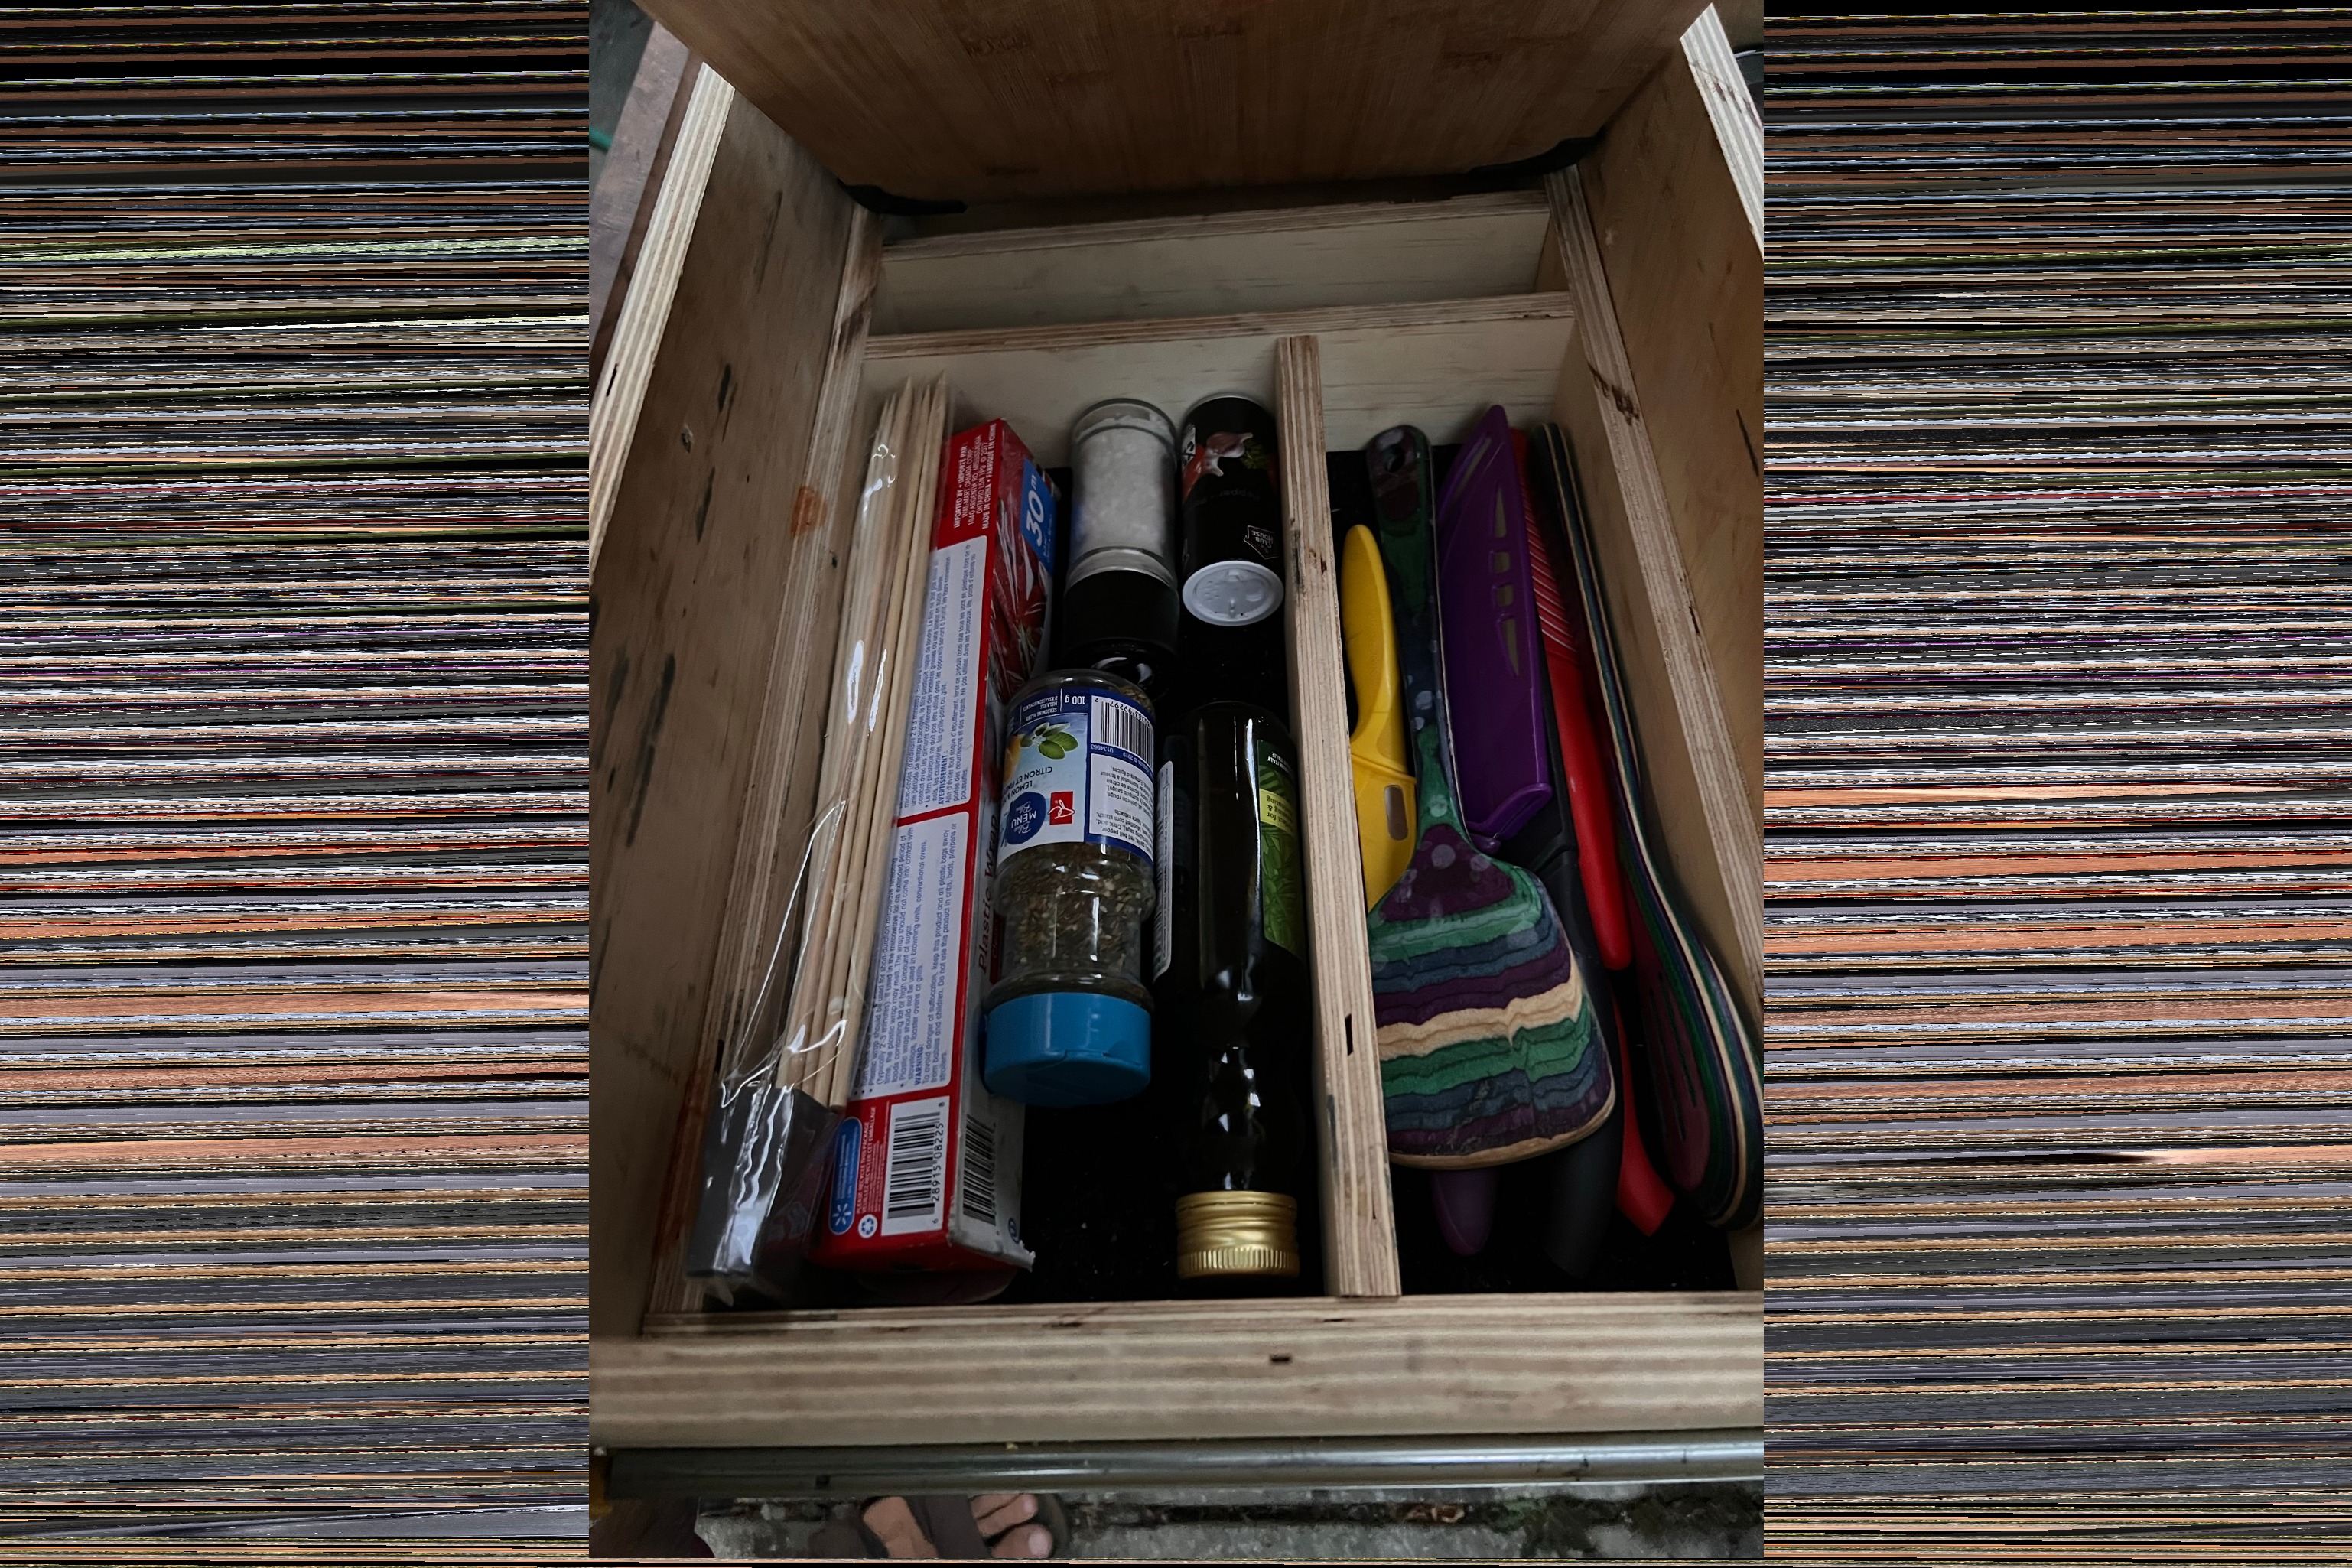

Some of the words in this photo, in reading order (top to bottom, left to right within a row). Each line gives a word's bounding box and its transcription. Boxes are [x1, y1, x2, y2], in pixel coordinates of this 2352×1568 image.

[964, 464, 972, 487] CANADA
[961, 487, 970, 518] WAL-MART
[975, 489, 984, 514] ONTARIO
[983, 482, 992, 503] CHINA
[953, 496, 962, 528] IMPORTED
[981, 510, 990, 529] MADE
[1025, 489, 1045, 547] 30
[1251, 529, 1274, 545] HOUSE
[1254, 535, 1272, 549] CLUB
[1072, 695, 1085, 705] 100
[1109, 701, 1133, 714] 99297
[1036, 707, 1058, 717] SEASONING
[1267, 756, 1280, 767] ITALY
[937, 753, 948, 805] AVERTISSEMENT
[1023, 766, 1053, 780] CITRON
[1011, 779, 1033, 797] LEMON
[1010, 810, 1037, 828] MENU
[1266, 812, 1277, 821] for
[904, 841, 912, 864] contact
[947, 830, 957, 859] playpens
[940, 847, 948, 864] bags
[914, 860, 925, 903] conventional
[938, 864, 948, 886] plastic
[935, 896, 944, 910] and
[897, 910, 906, 934] should
[933, 911, 944, 938] product
[941, 906, 952, 933] product
[975, 886, 992, 973] Plastic
[896, 935, 905, 952] wrap
[909, 922, 921, 955] browning
[893, 953, 902, 967] The
[899, 954, 909, 981] amount
[931, 952, 941, 970] keep
[938, 961, 946, 974] not
[906, 965, 916, 982] used
[892, 987, 900, 1004] may
[897, 982, 908, 999] high
[904, 994, 912, 1007] not
[890, 1004, 899, 1024] wrap
[896, 1009, 904, 1020] fat
[902, 1007, 912, 1033] should
[885, 1025, 897, 1049] plastic
[909, 1015, 918, 1040] toaster
[924, 1023, 935, 1049] danger
[932, 1020, 942, 1036] and
[892, 1020, 905, 1060] containing
[902, 1033, 911, 1053] wrap
[930, 1037, 940, 1063] babies
[884, 1050, 893, 1063] the
[913, 1043, 924, 1085] WARNING:
[922, 1051, 932, 1073] avoid
[890, 1061, 899, 1082] foods
[897, 1055, 907, 1081] Plastic
[929, 1063, 938, 1083] from
[932, 1122, 944, 1160] 08225
[930, 1164, 942, 1202] 28915
